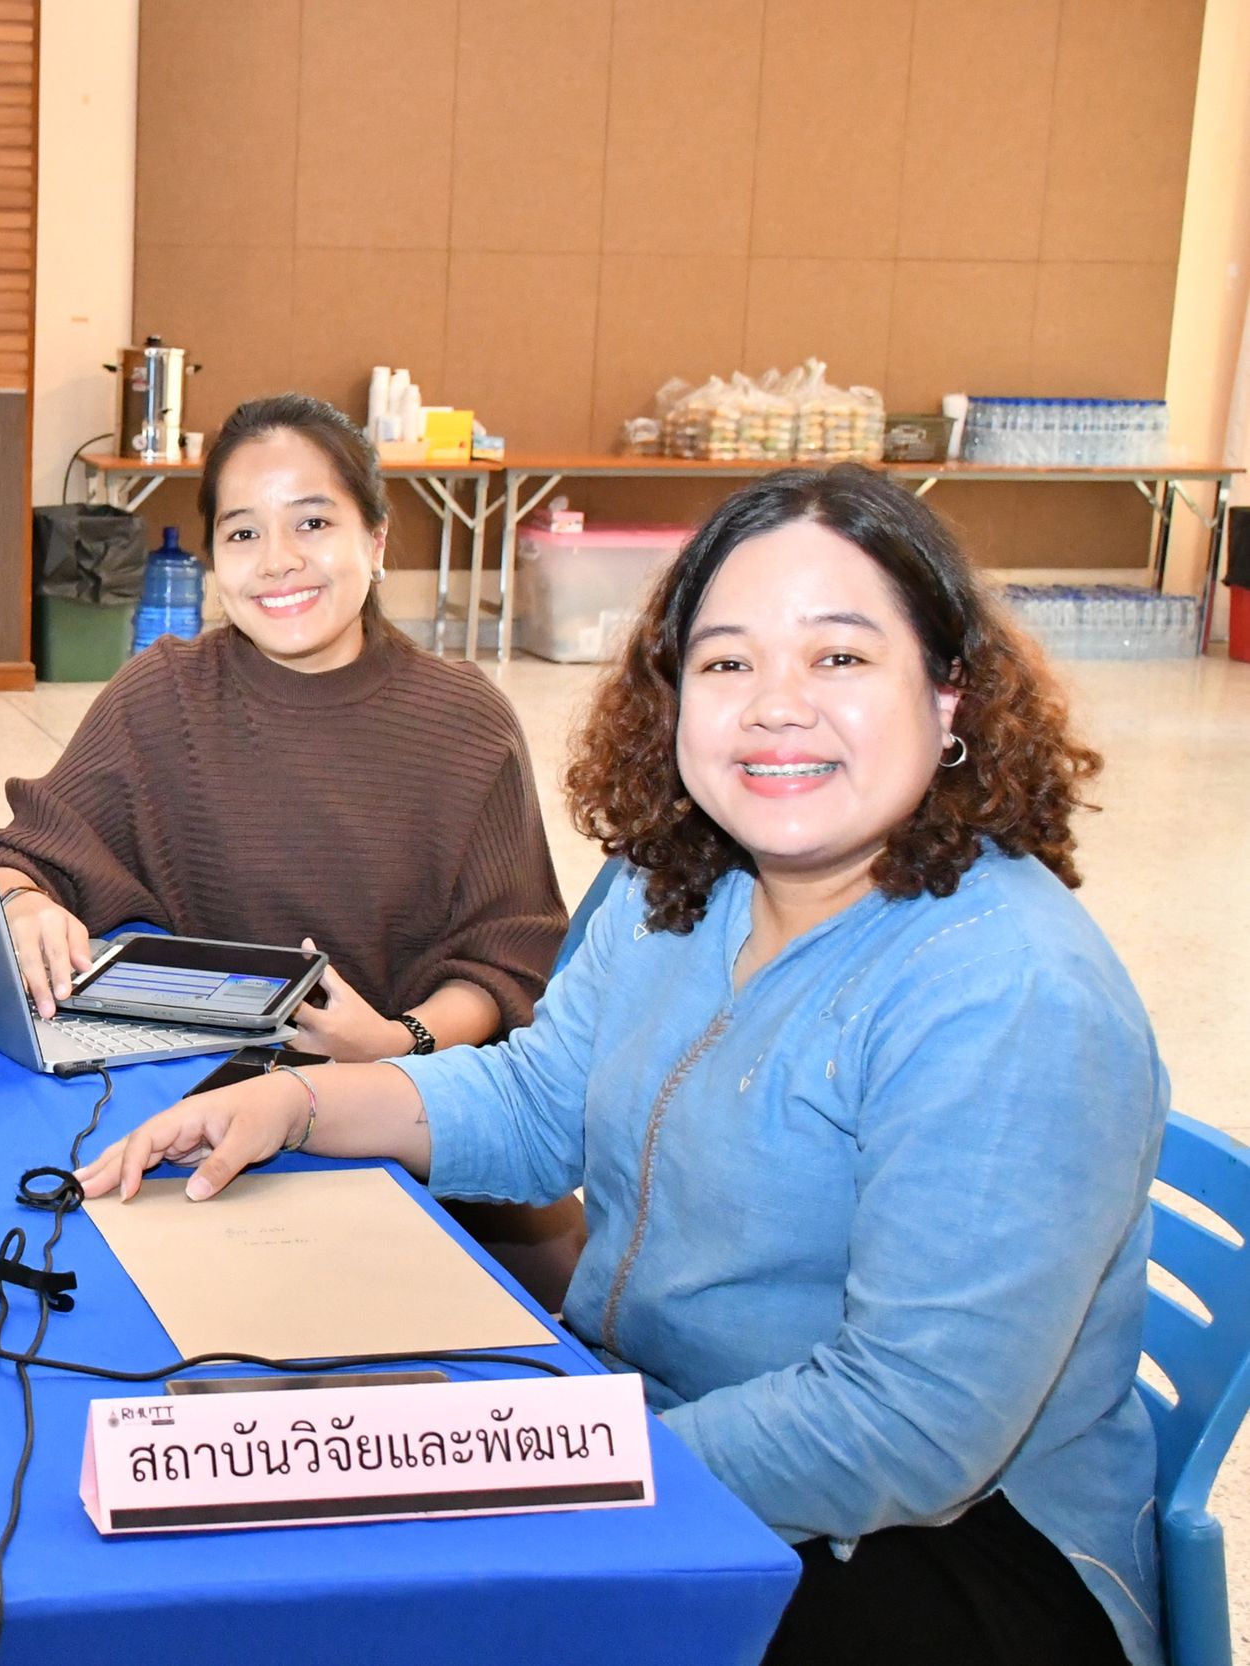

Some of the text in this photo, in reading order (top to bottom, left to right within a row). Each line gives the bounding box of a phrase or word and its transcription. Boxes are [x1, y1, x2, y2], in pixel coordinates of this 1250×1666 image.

[129, 1407, 616, 1483] สถาบันวิจัยและพัฒนา
